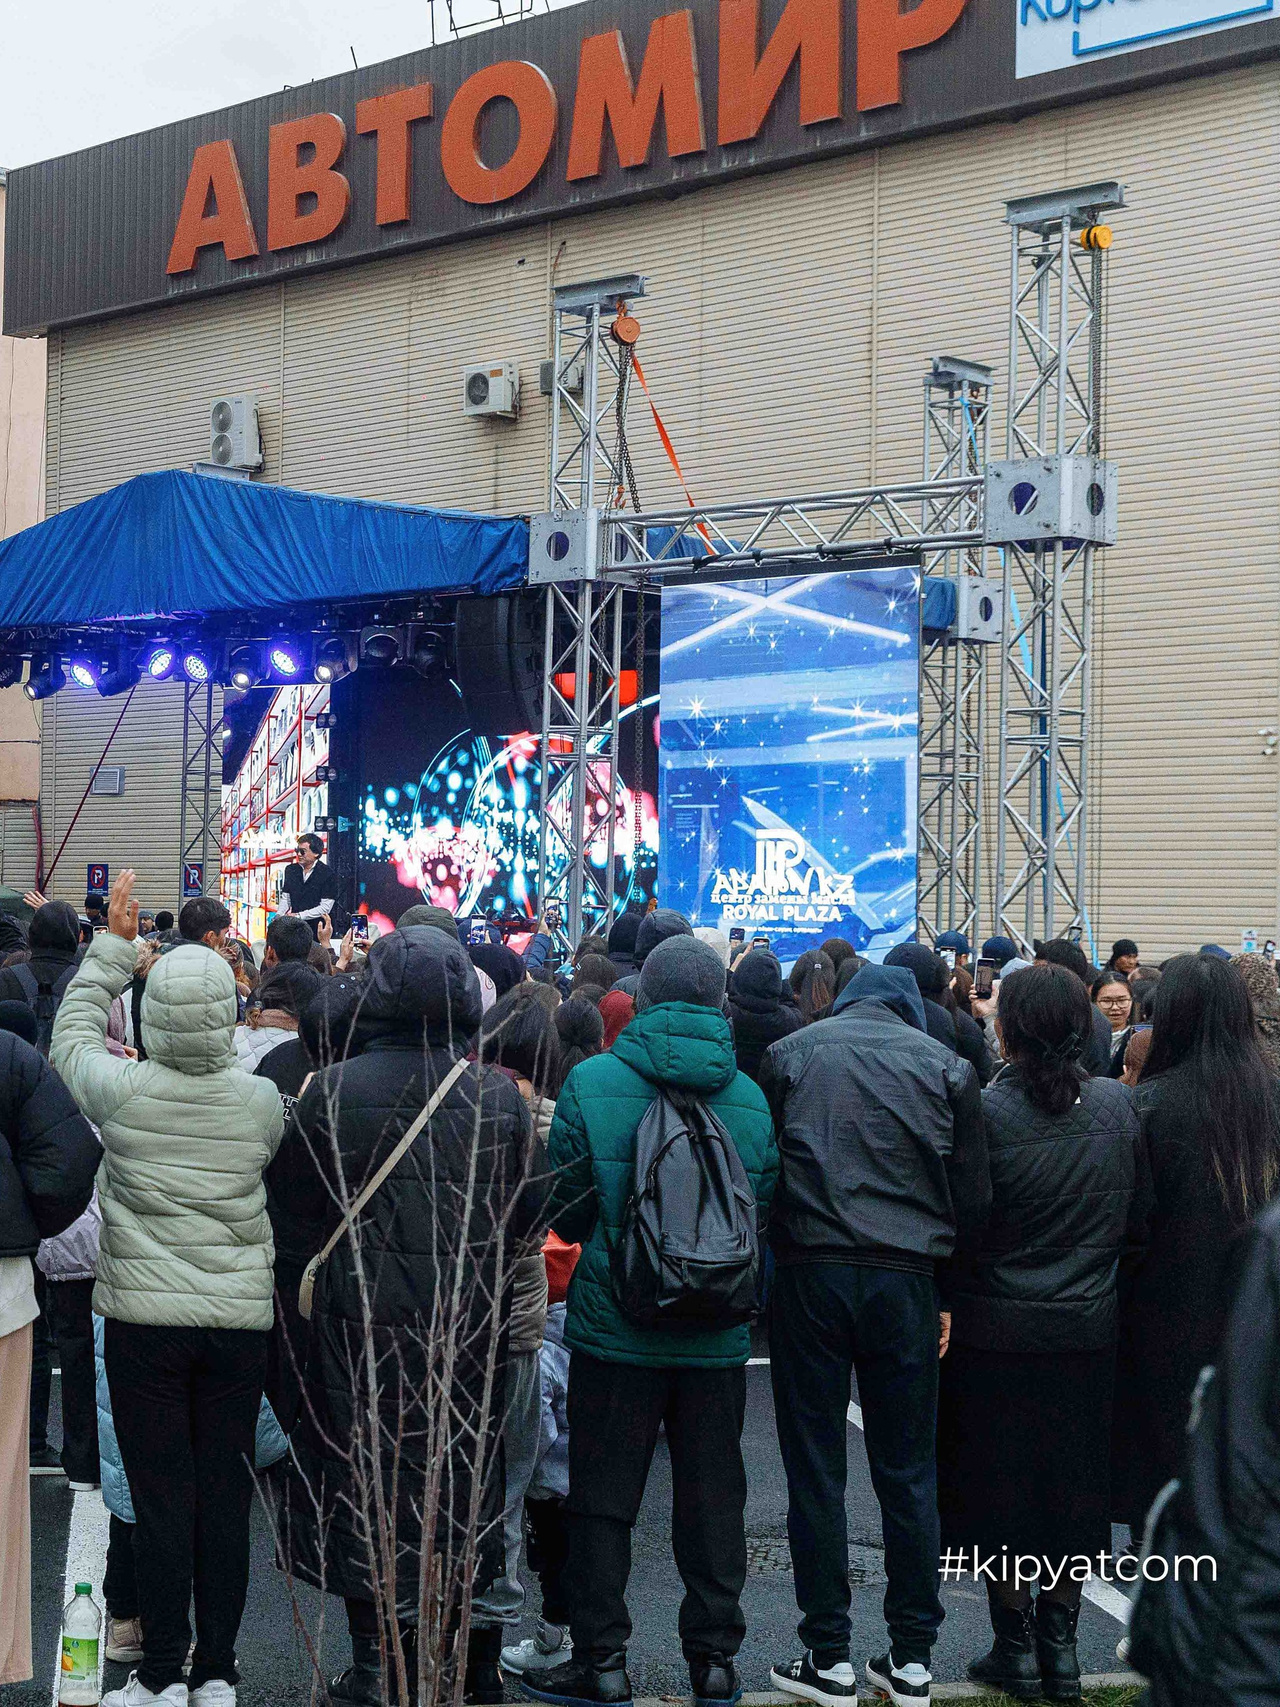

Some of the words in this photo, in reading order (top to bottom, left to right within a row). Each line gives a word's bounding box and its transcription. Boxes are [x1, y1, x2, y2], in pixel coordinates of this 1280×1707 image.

[165, 0, 968, 276] АВТОМИР
[723, 905, 779, 920] ROYAL
[783, 906, 843, 922] PLAZA
